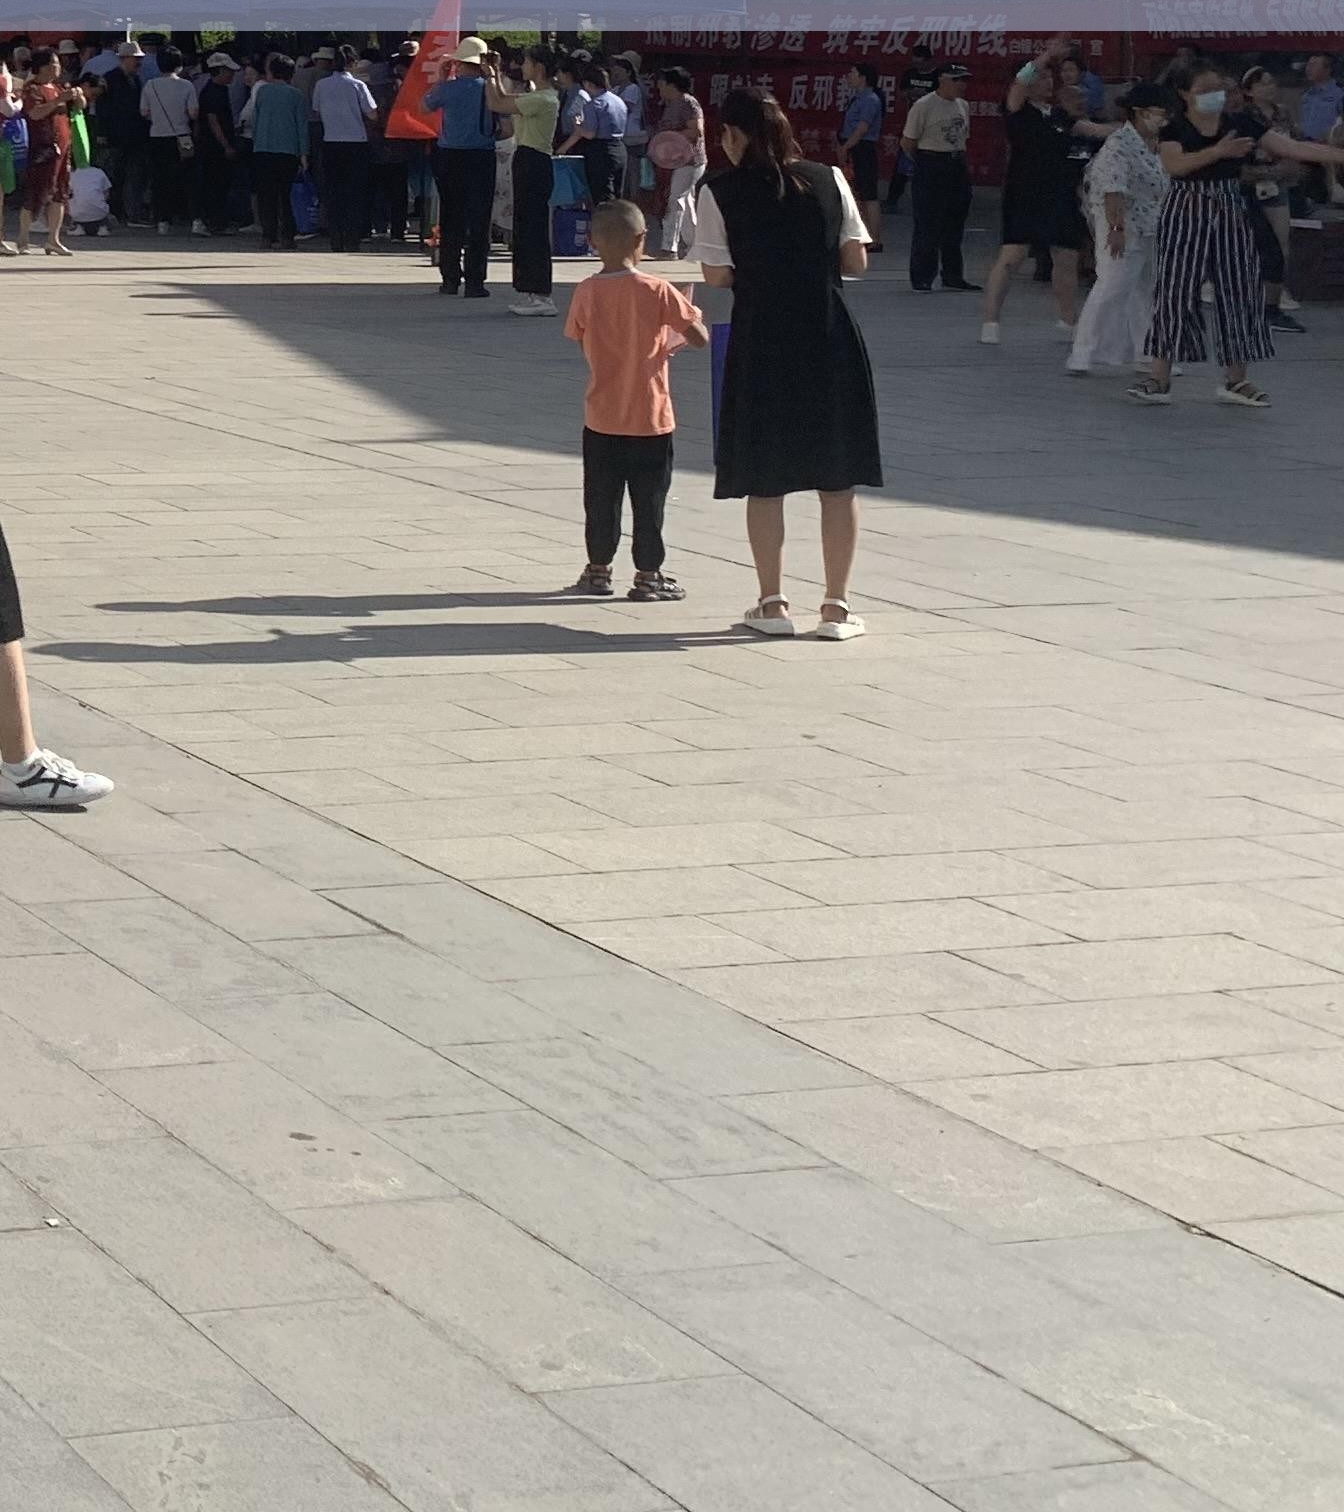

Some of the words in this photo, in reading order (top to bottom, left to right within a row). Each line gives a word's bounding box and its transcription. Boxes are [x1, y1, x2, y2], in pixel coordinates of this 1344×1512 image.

[822, 10, 1009, 57] 筑牢反邪防线
